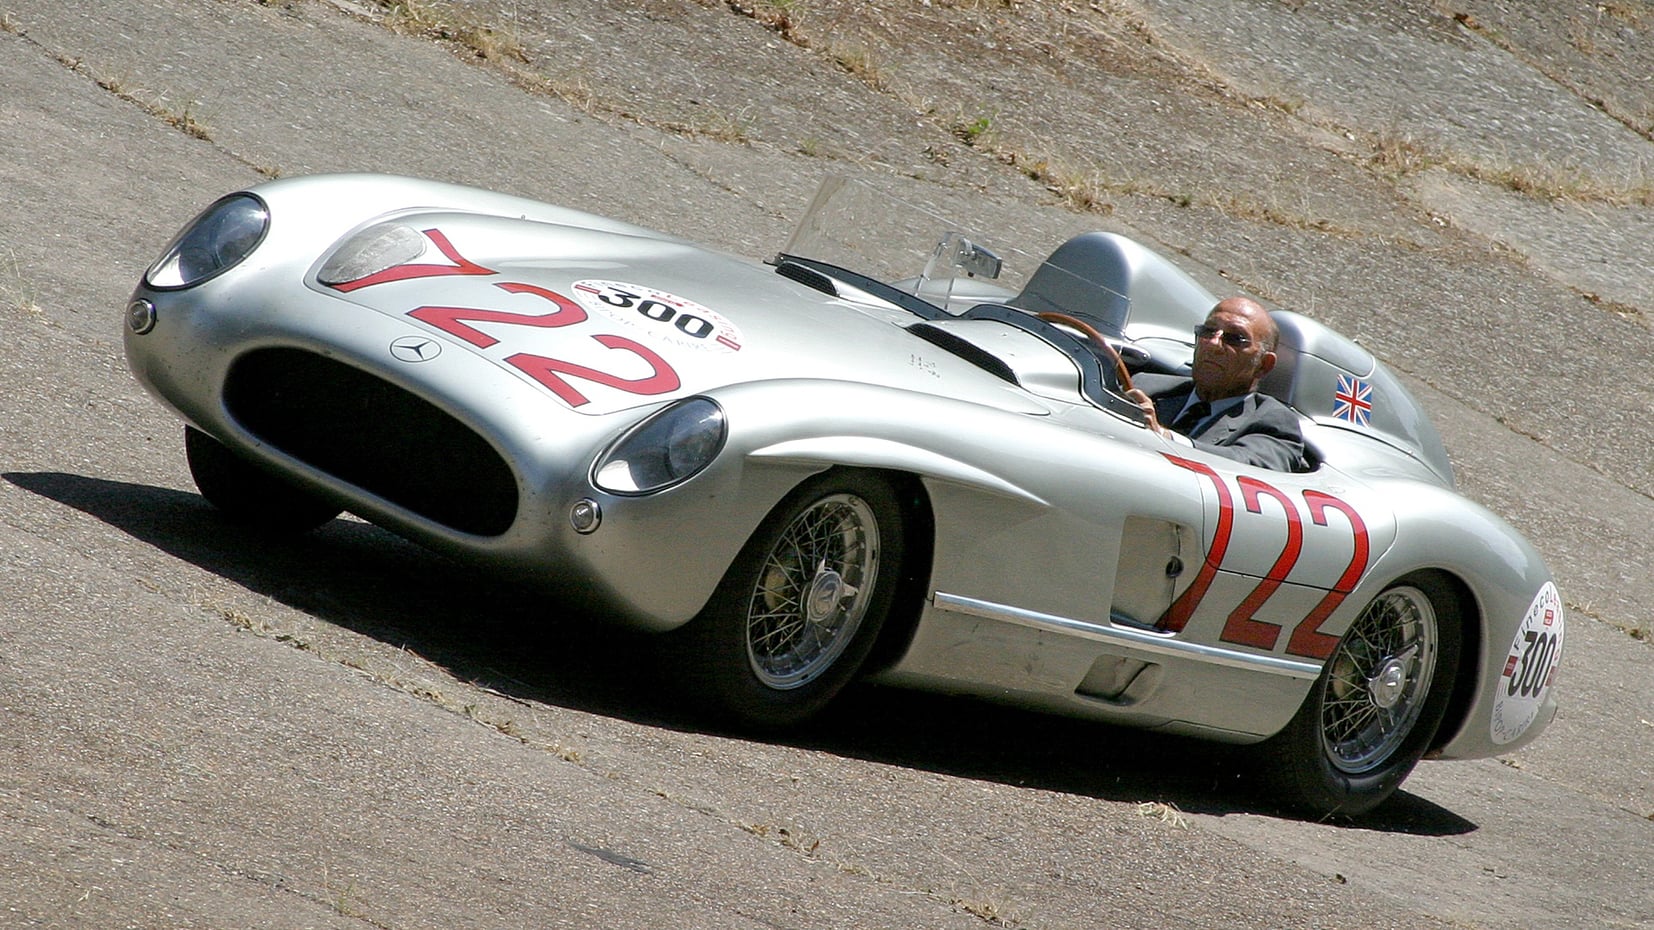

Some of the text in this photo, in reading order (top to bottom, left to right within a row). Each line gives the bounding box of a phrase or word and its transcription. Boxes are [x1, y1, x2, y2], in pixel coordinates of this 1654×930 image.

[328, 228, 681, 408] 722
[598, 286, 715, 339] 300
[1156, 450, 1370, 661] 722
[1507, 630, 1557, 698] 300
